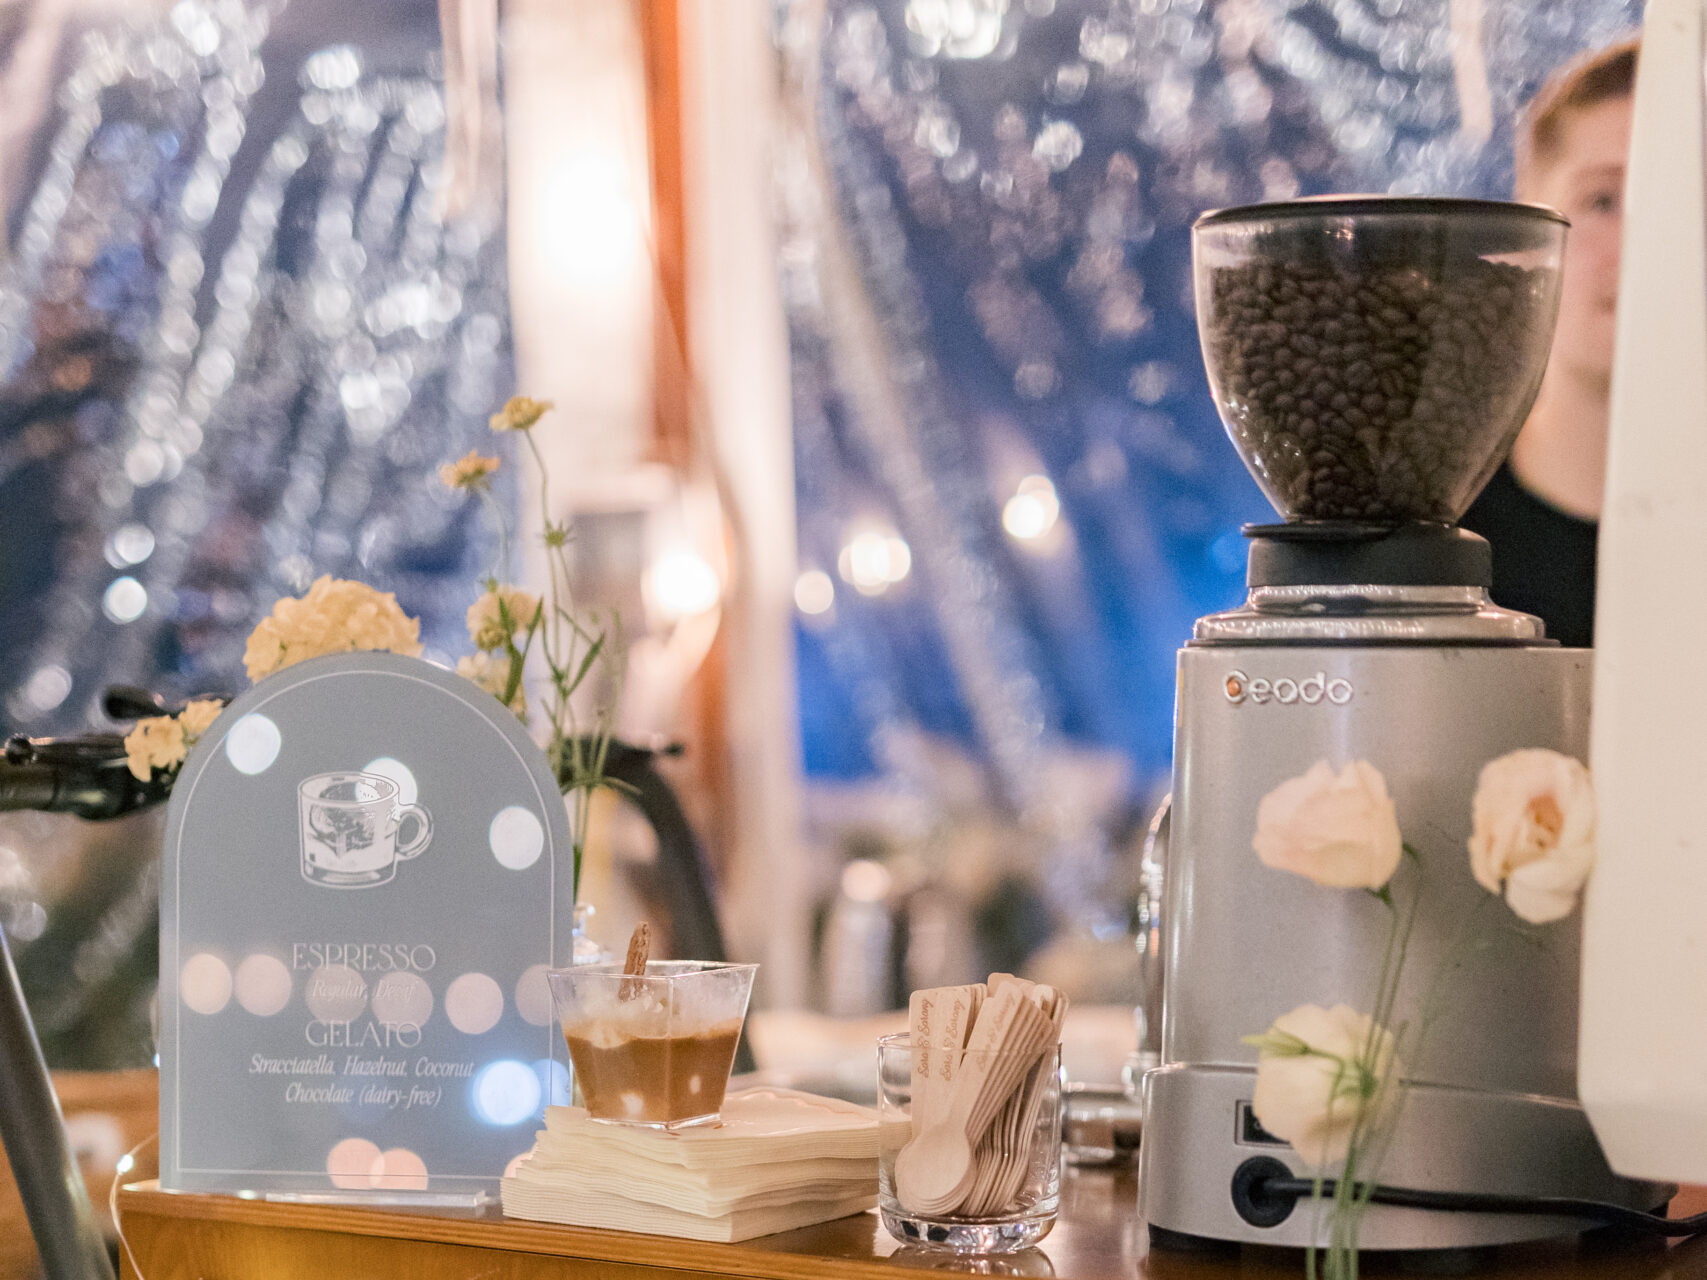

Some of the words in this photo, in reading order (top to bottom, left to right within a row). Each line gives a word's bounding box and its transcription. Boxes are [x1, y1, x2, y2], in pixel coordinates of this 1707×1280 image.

[292, 943, 437, 972] ESPRESSO
[305, 1020, 422, 1048] GELATO
[285, 1082, 358, 1105] Chocolate
[358, 1085, 443, 1110] (dairy-free)
